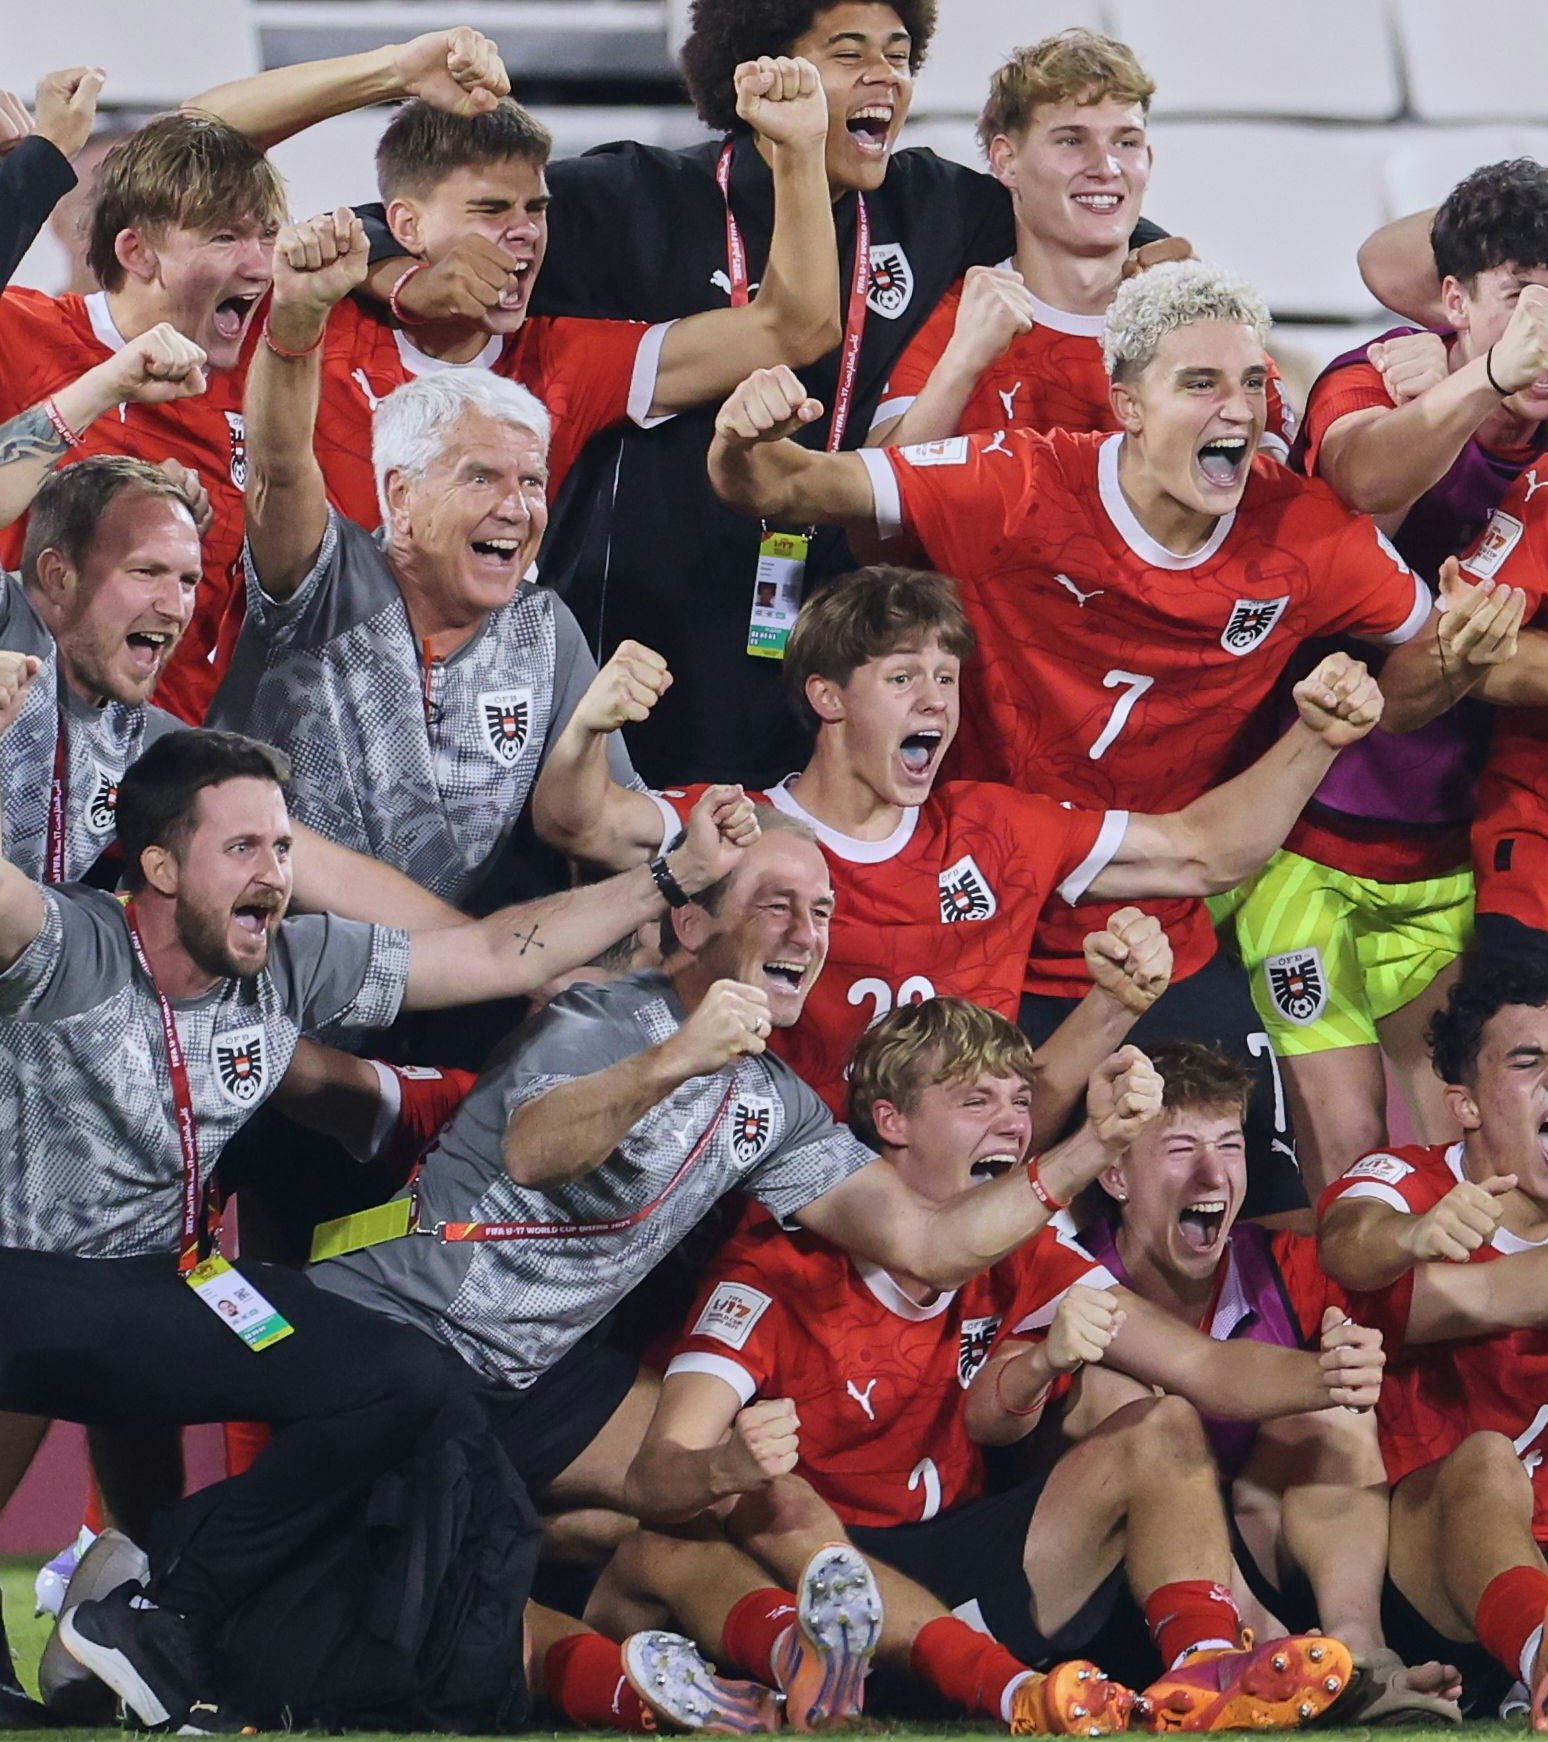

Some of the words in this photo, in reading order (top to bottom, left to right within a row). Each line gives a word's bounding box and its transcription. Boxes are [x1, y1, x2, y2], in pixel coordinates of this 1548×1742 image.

[857, 276, 866, 294] FIFA
[1089, 669, 1154, 760] 7
[485, 1226, 505, 1236] FIFA
[505, 1226, 525, 1236] U-17
[526, 1225, 558, 1236] WORLD
[559, 1225, 577, 1233] CUP
